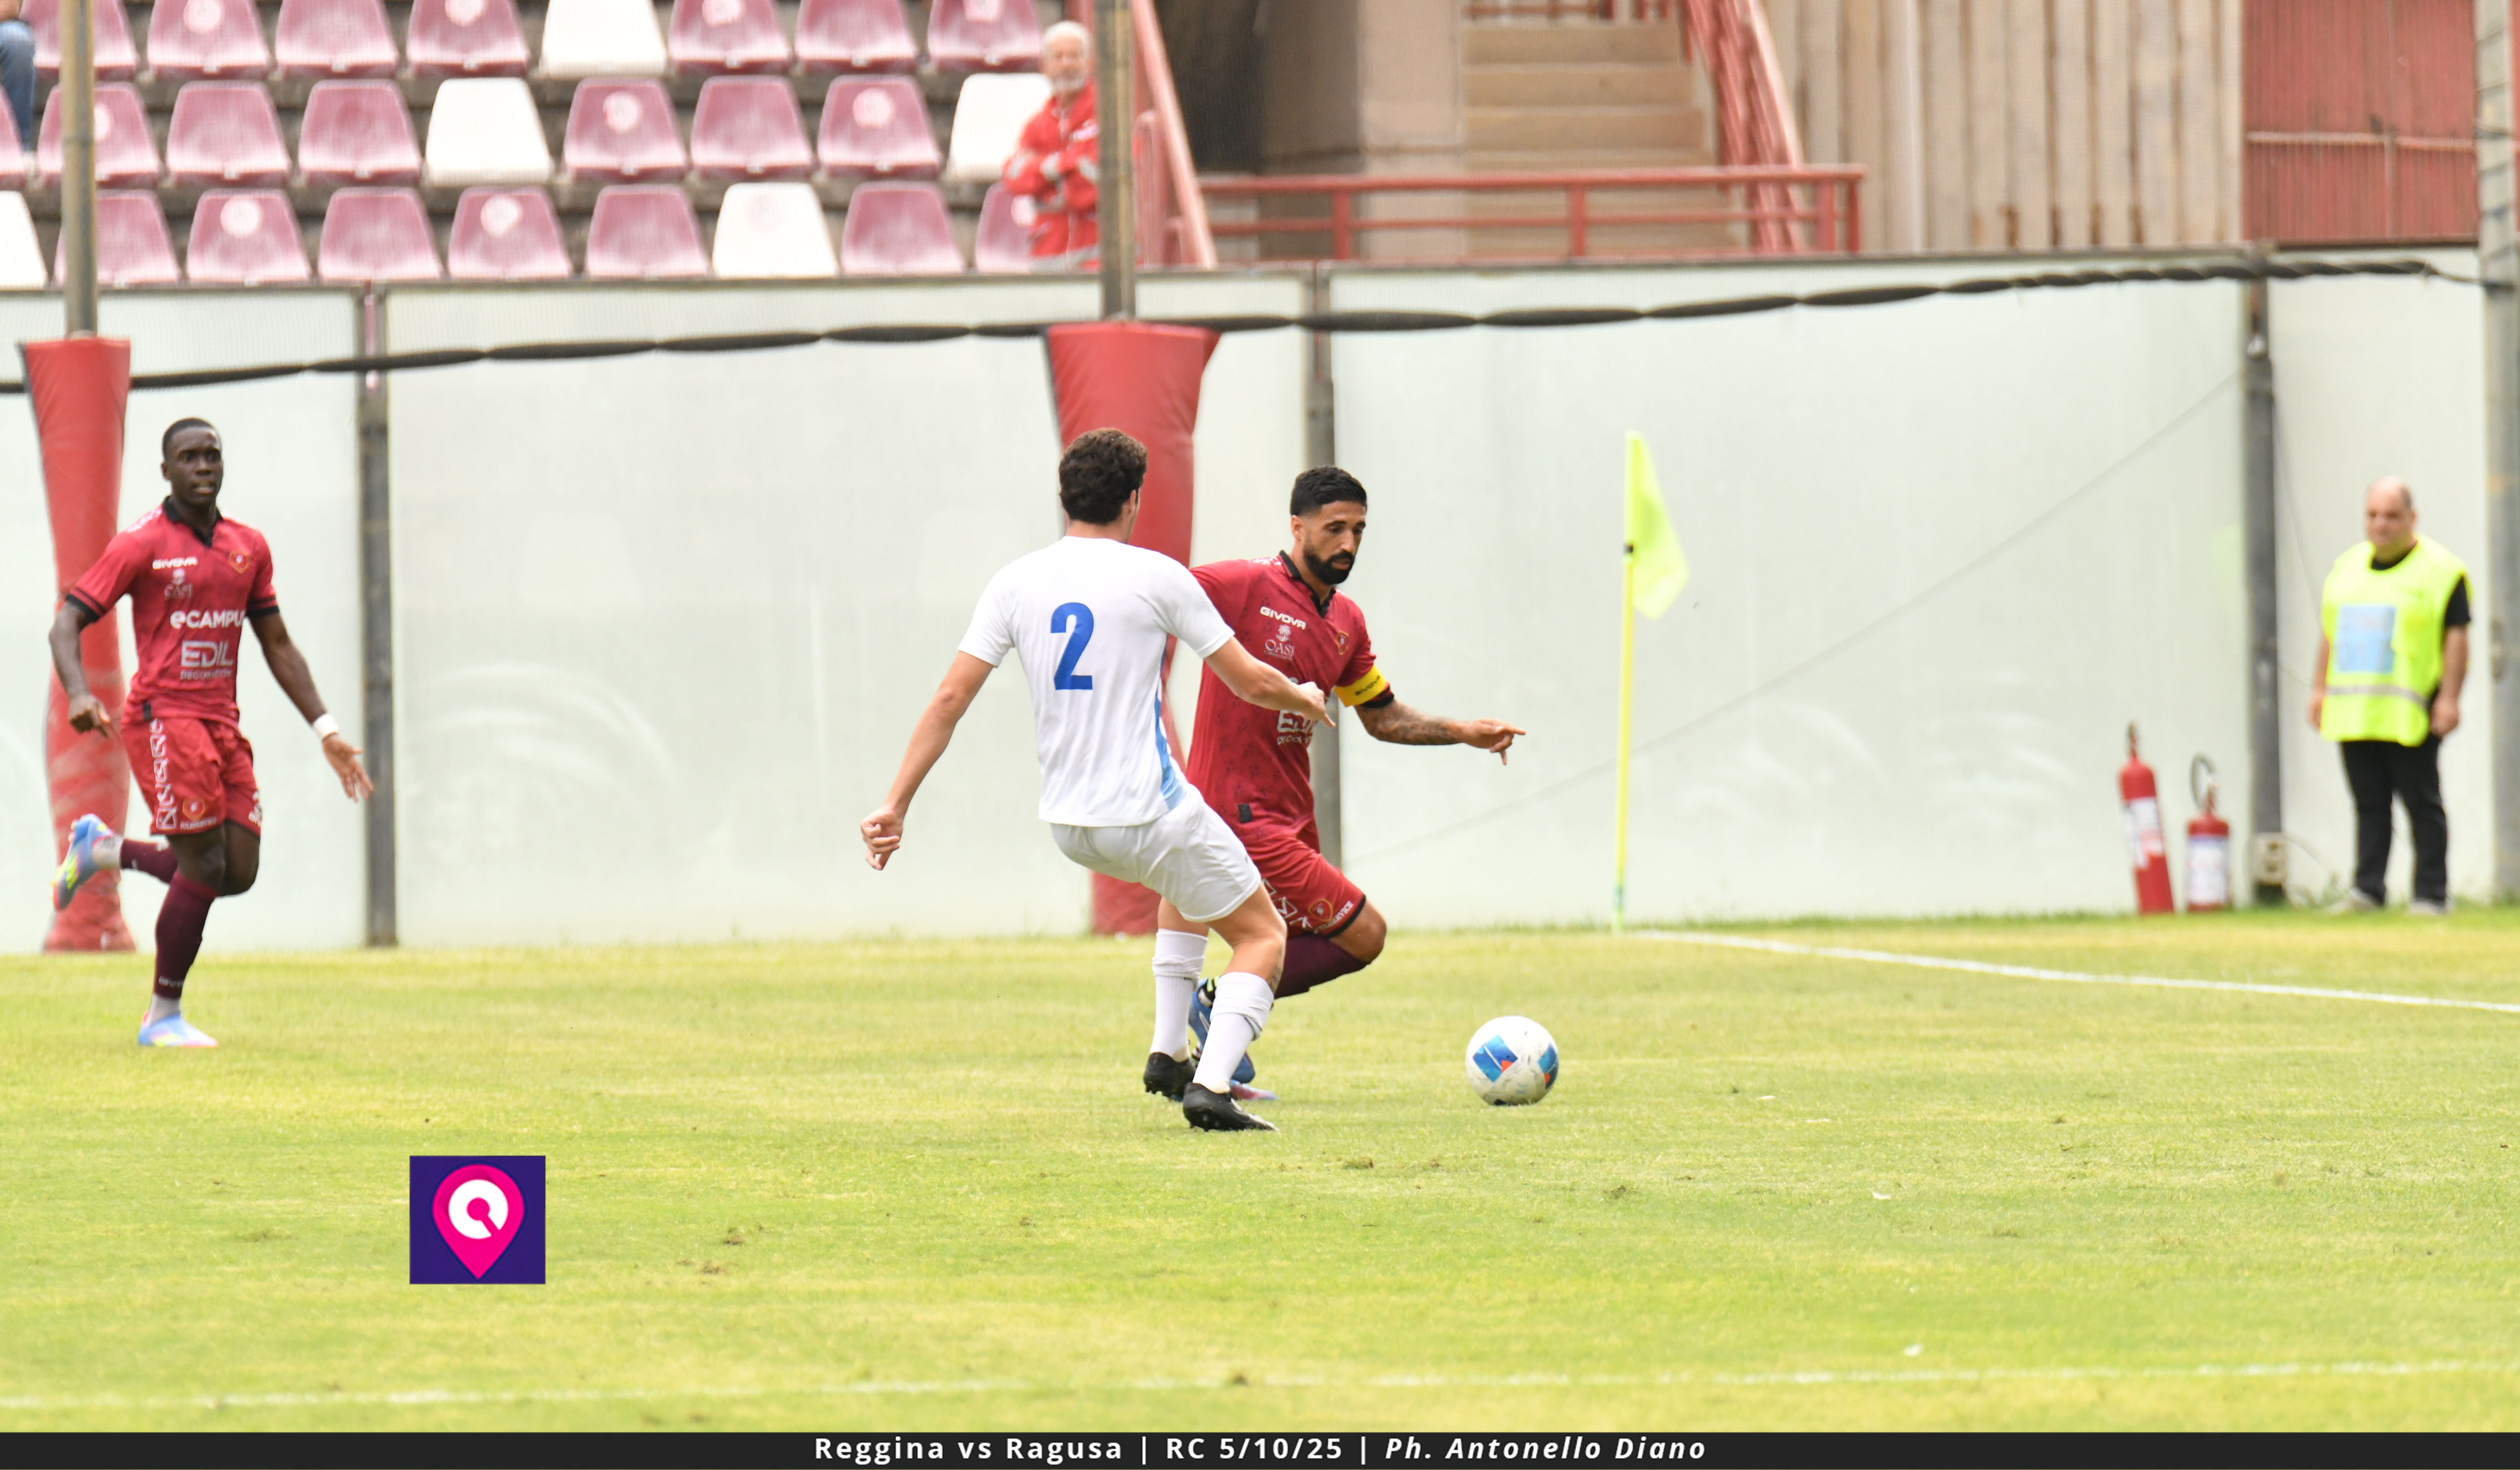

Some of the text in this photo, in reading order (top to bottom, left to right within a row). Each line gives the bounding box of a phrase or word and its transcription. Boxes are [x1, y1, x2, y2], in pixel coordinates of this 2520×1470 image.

[1260, 606, 1306, 630] GIVOVA
[181, 641, 234, 667] EDIL
[1050, 602, 1094, 691] 2
